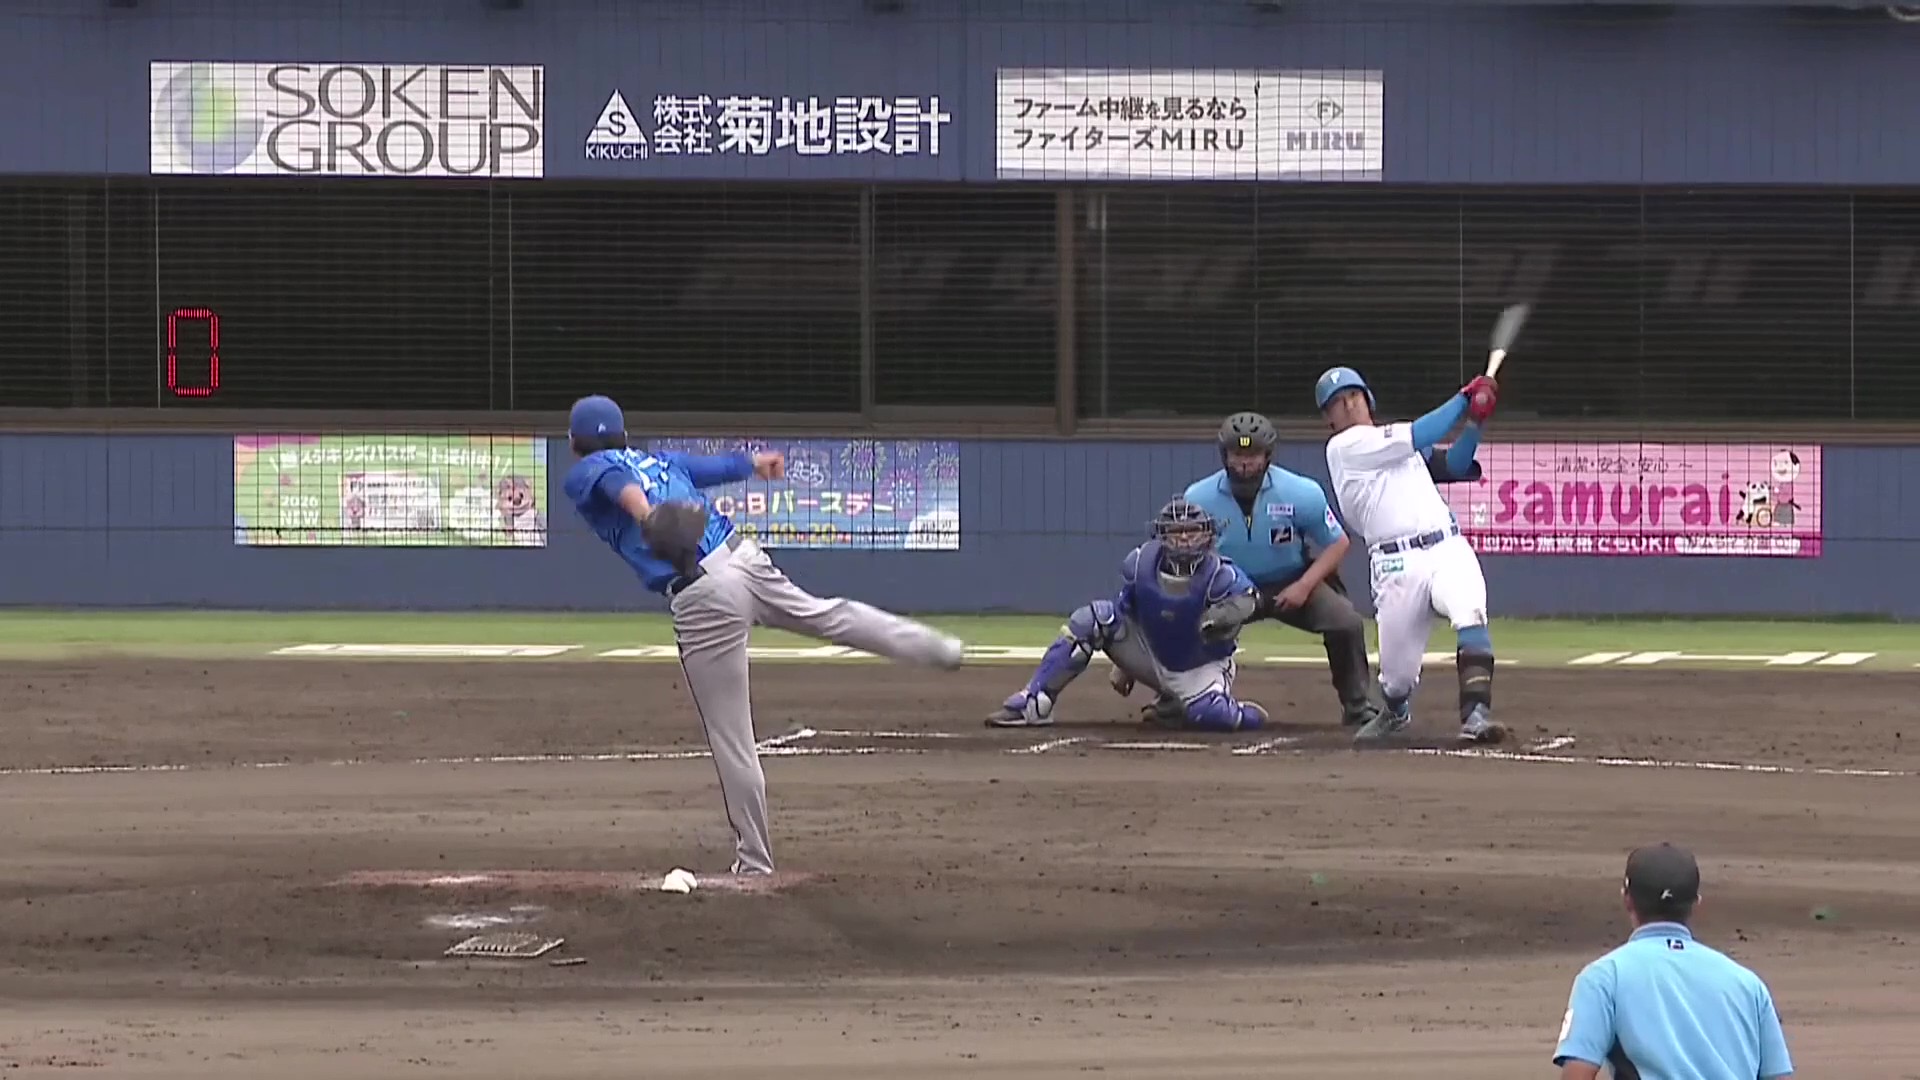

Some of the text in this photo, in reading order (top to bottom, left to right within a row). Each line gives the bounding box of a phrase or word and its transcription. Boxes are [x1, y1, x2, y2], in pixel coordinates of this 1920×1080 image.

[266, 65, 541, 121] SOKEN
[609, 111, 626, 137] S
[652, 94, 713, 125] 株式
[1013, 96, 1248, 122] ファーム中継を見るなら
[652, 125, 713, 155] 会社
[716, 95, 952, 156] 菊地設計
[1013, 126, 1245, 151] ファイターズMIRU
[266, 119, 540, 175] GROUP
[585, 145, 649, 160] KIKUCHI
[1286, 131, 1365, 151] MIRU
[167, 308, 220, 397] 0
[1494, 473, 1731, 526] samurai
